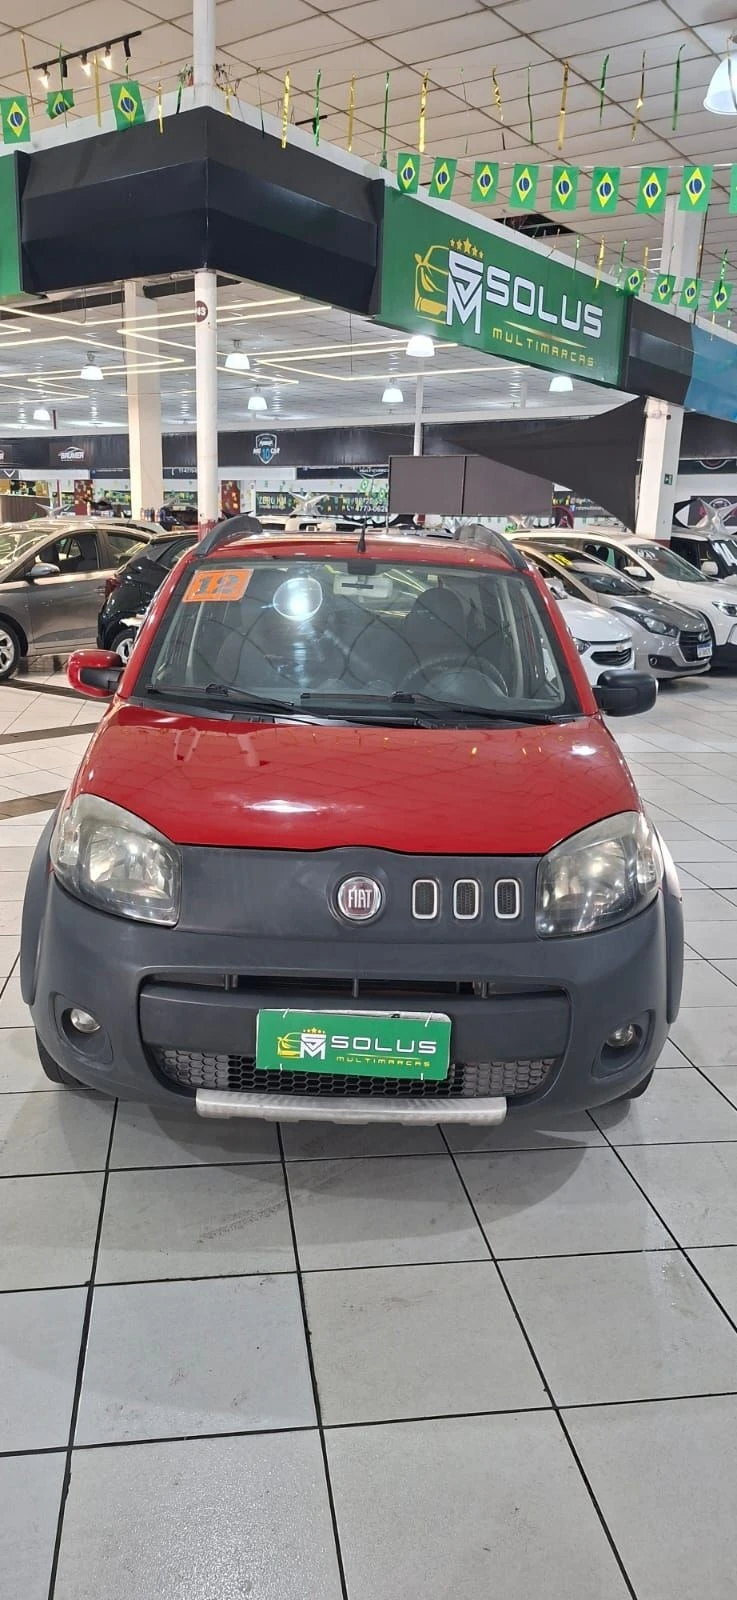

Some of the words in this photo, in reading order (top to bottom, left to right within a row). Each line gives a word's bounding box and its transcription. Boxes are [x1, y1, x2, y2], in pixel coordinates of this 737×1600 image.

[485, 265, 603, 339] SOLUS
[492, 327, 595, 368] MULTIMARCAS
[348, 886, 373, 909] FIAT
[330, 1035, 437, 1054] SOLUS
[336, 1056, 431, 1068] MULTIMARCAS
